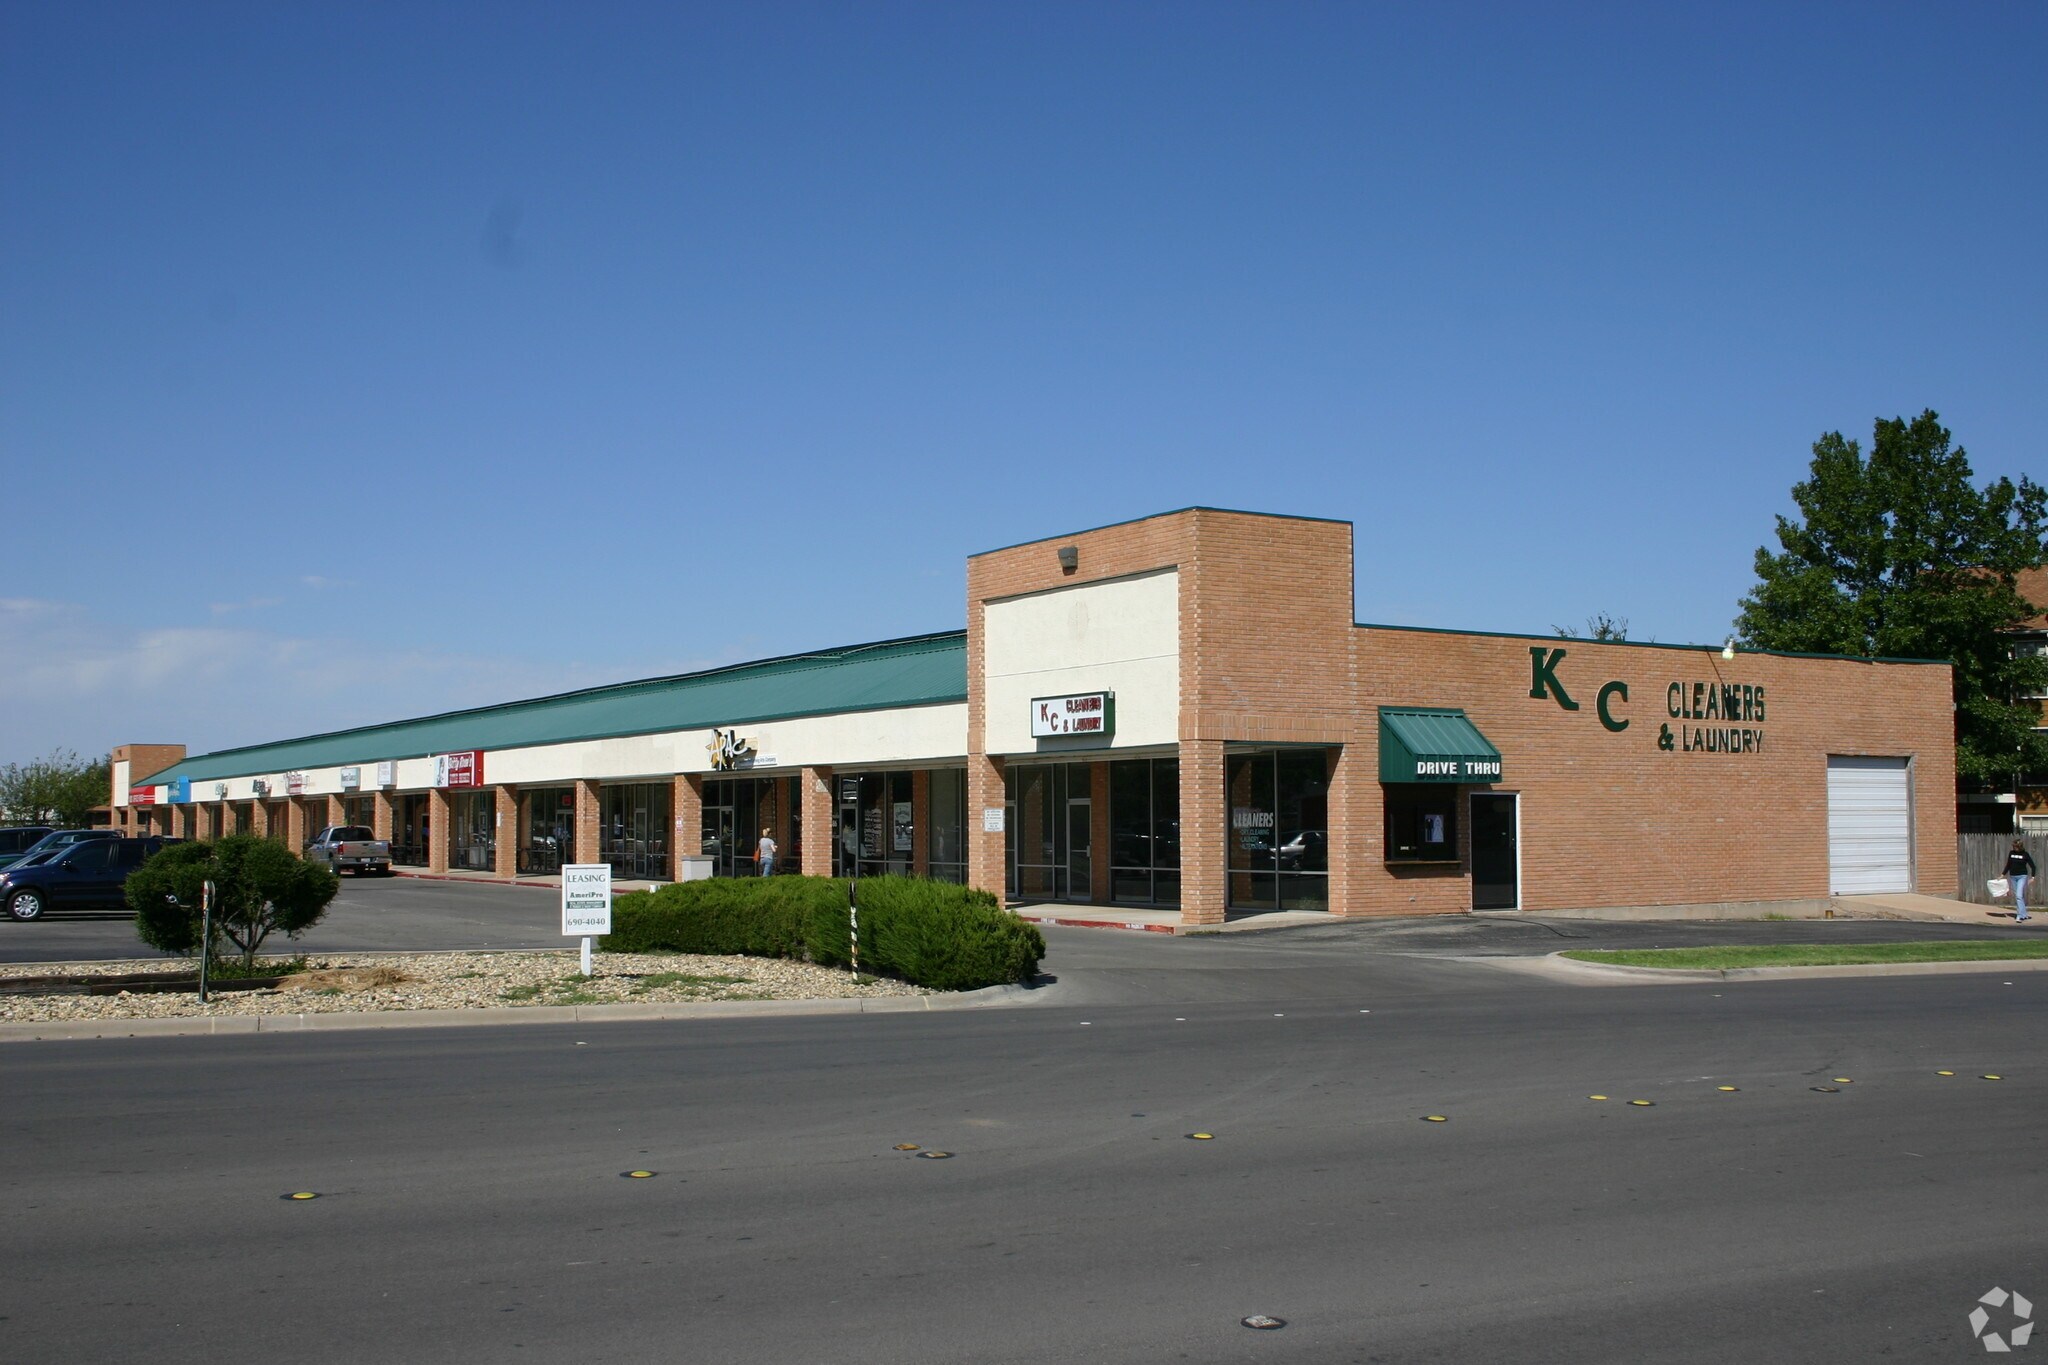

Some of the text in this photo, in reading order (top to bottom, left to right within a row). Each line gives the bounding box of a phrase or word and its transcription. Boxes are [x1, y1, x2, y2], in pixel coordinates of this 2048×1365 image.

[1528, 646, 1629, 732] K C
[1666, 681, 1765, 722] CLEANERS
[1041, 703, 1058, 731] K C
[1657, 722, 1762, 753] & LAUNDRY
[1417, 762, 1500, 774] DRIVE THRU
[568, 874, 605, 882] LEASING
[568, 918, 605, 926] 690-4040
